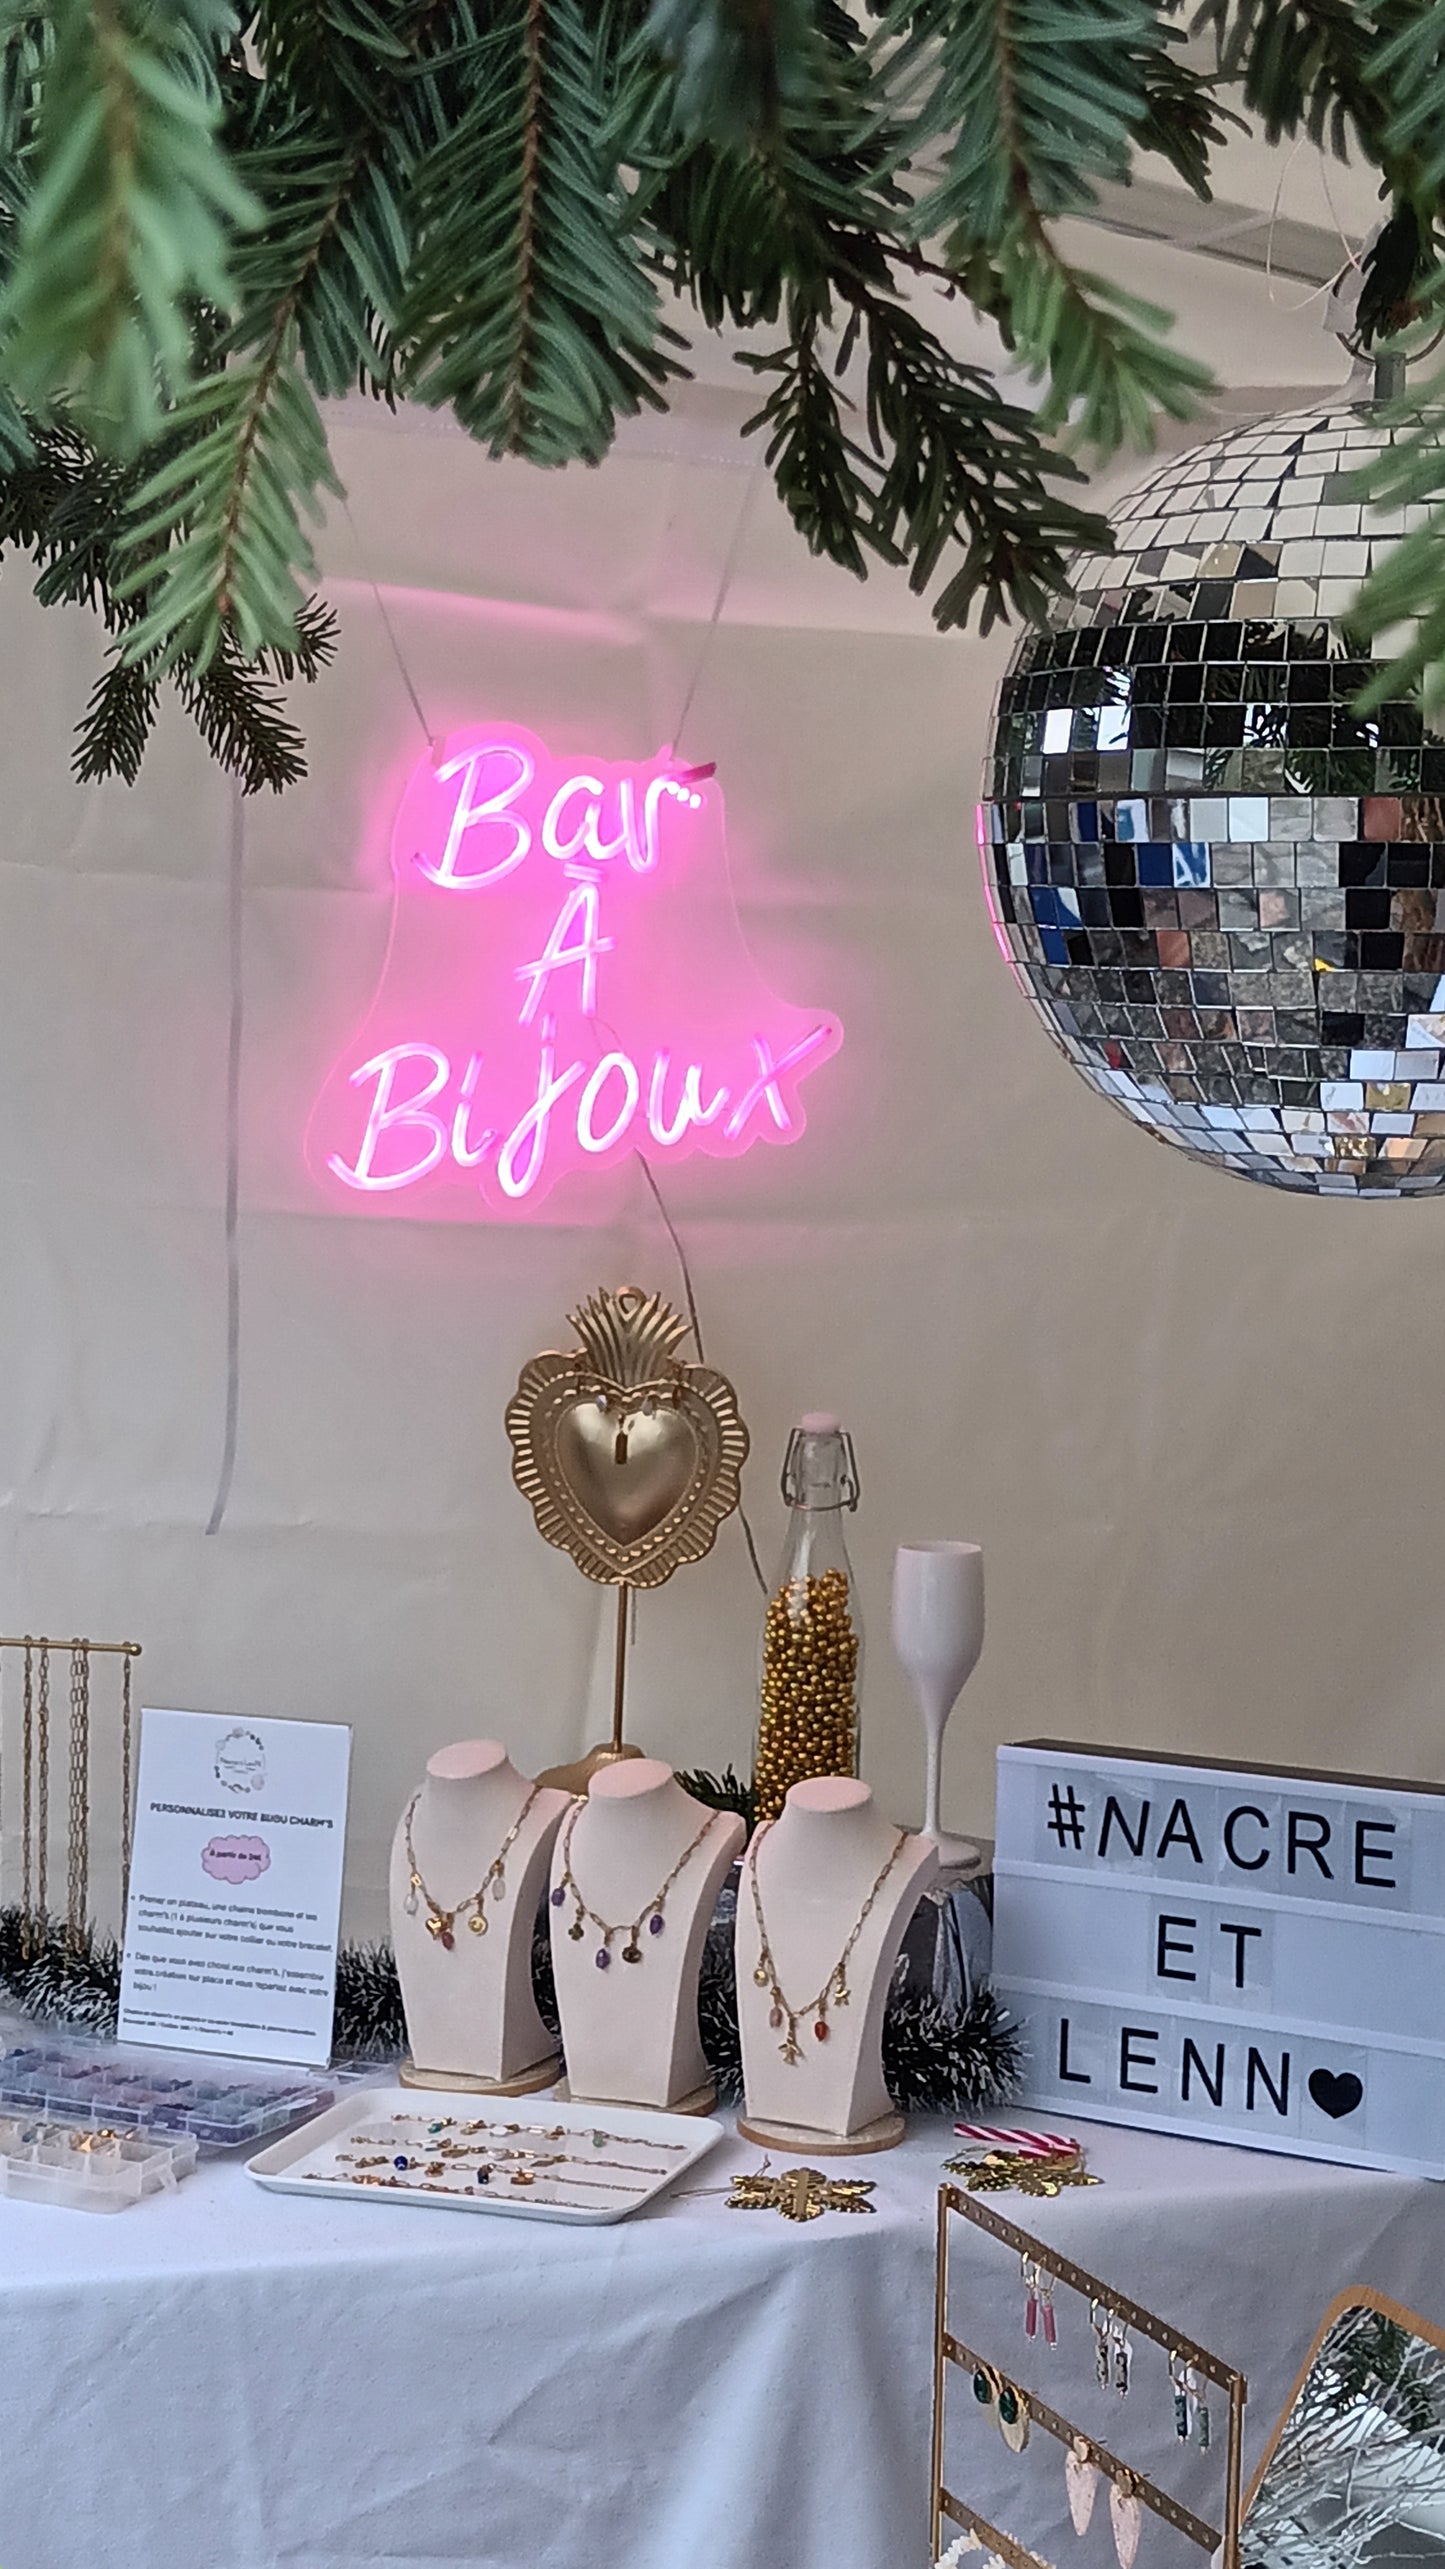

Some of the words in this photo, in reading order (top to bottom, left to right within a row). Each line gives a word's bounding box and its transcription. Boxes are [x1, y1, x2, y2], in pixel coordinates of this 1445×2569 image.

[411, 740, 702, 890] Bar
[327, 1012, 833, 1199] Bijoux
[228, 1810, 258, 1821] VOTRE
[260, 1813, 288, 1825] BIJOU
[1047, 1783, 1397, 1889] #NACRE
[1157, 1914, 1263, 1989] ET
[1058, 2018, 1291, 2117] LENN
